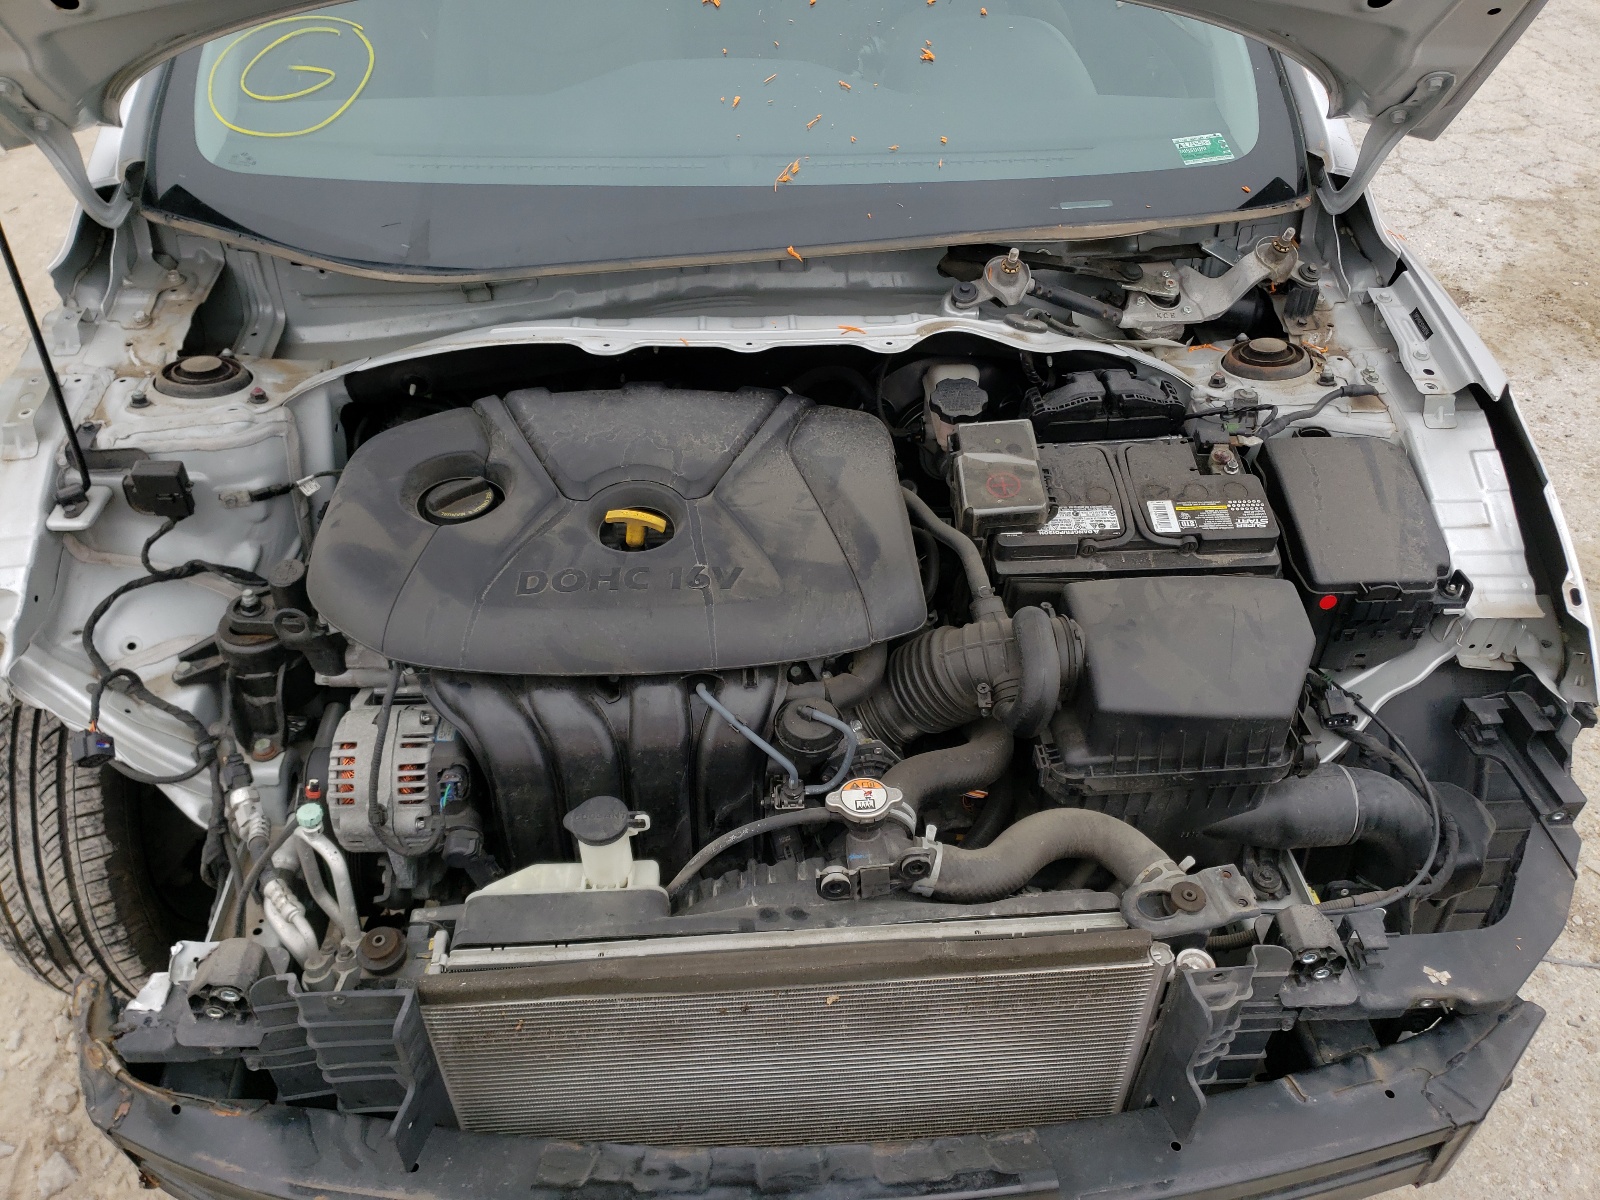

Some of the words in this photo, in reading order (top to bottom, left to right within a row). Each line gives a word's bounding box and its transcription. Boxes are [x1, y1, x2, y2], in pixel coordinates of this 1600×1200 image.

[515, 566, 651, 596] DOHC
[668, 565, 744, 591] 16V
[574, 811, 627, 821] COOLANT
